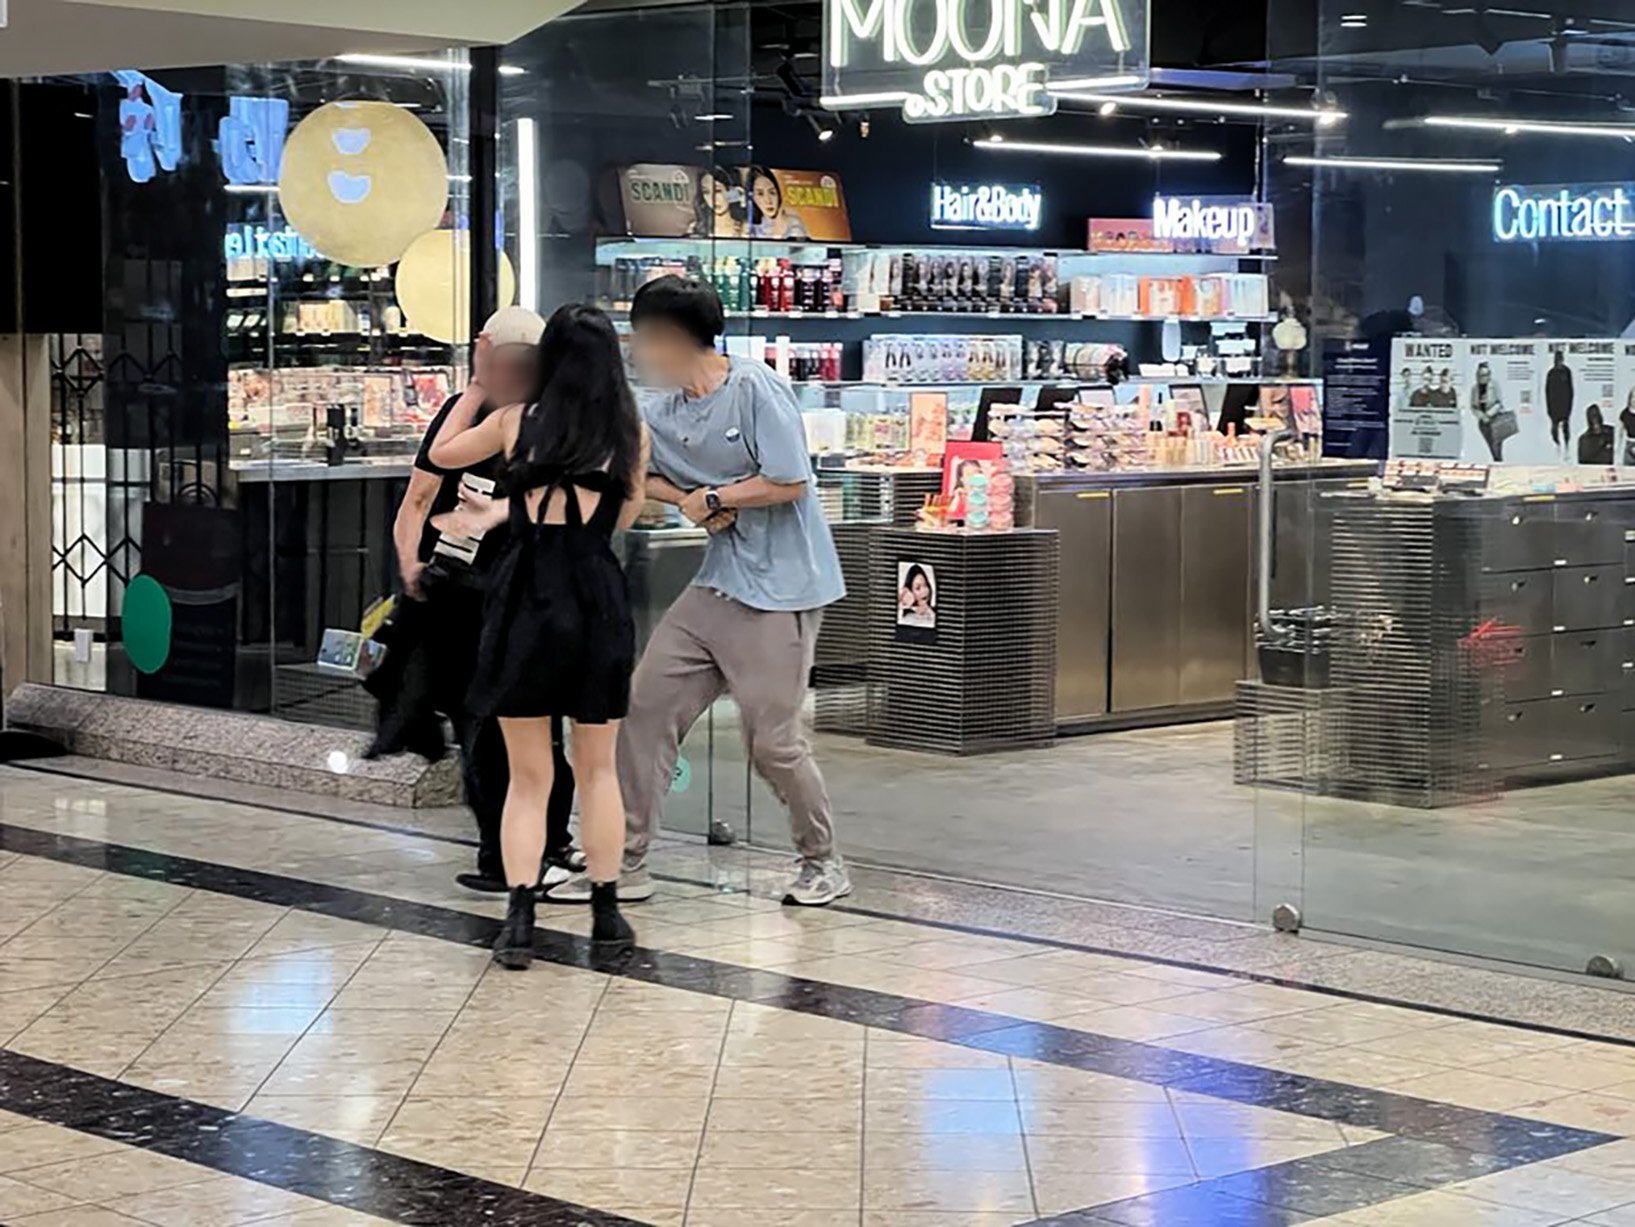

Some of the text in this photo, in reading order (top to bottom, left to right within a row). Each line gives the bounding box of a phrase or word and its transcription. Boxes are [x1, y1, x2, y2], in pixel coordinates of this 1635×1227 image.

[830, 0, 1130, 67] MOONA
[922, 62, 1044, 116] STORE
[630, 180, 690, 203] SCANDI
[785, 183, 840, 208] SCANDI
[933, 185, 1042, 230] Hair&Body
[1494, 188, 1631, 239] Contact
[1153, 198, 1255, 247] Makeup
[1404, 343, 1453, 359] WANTED
